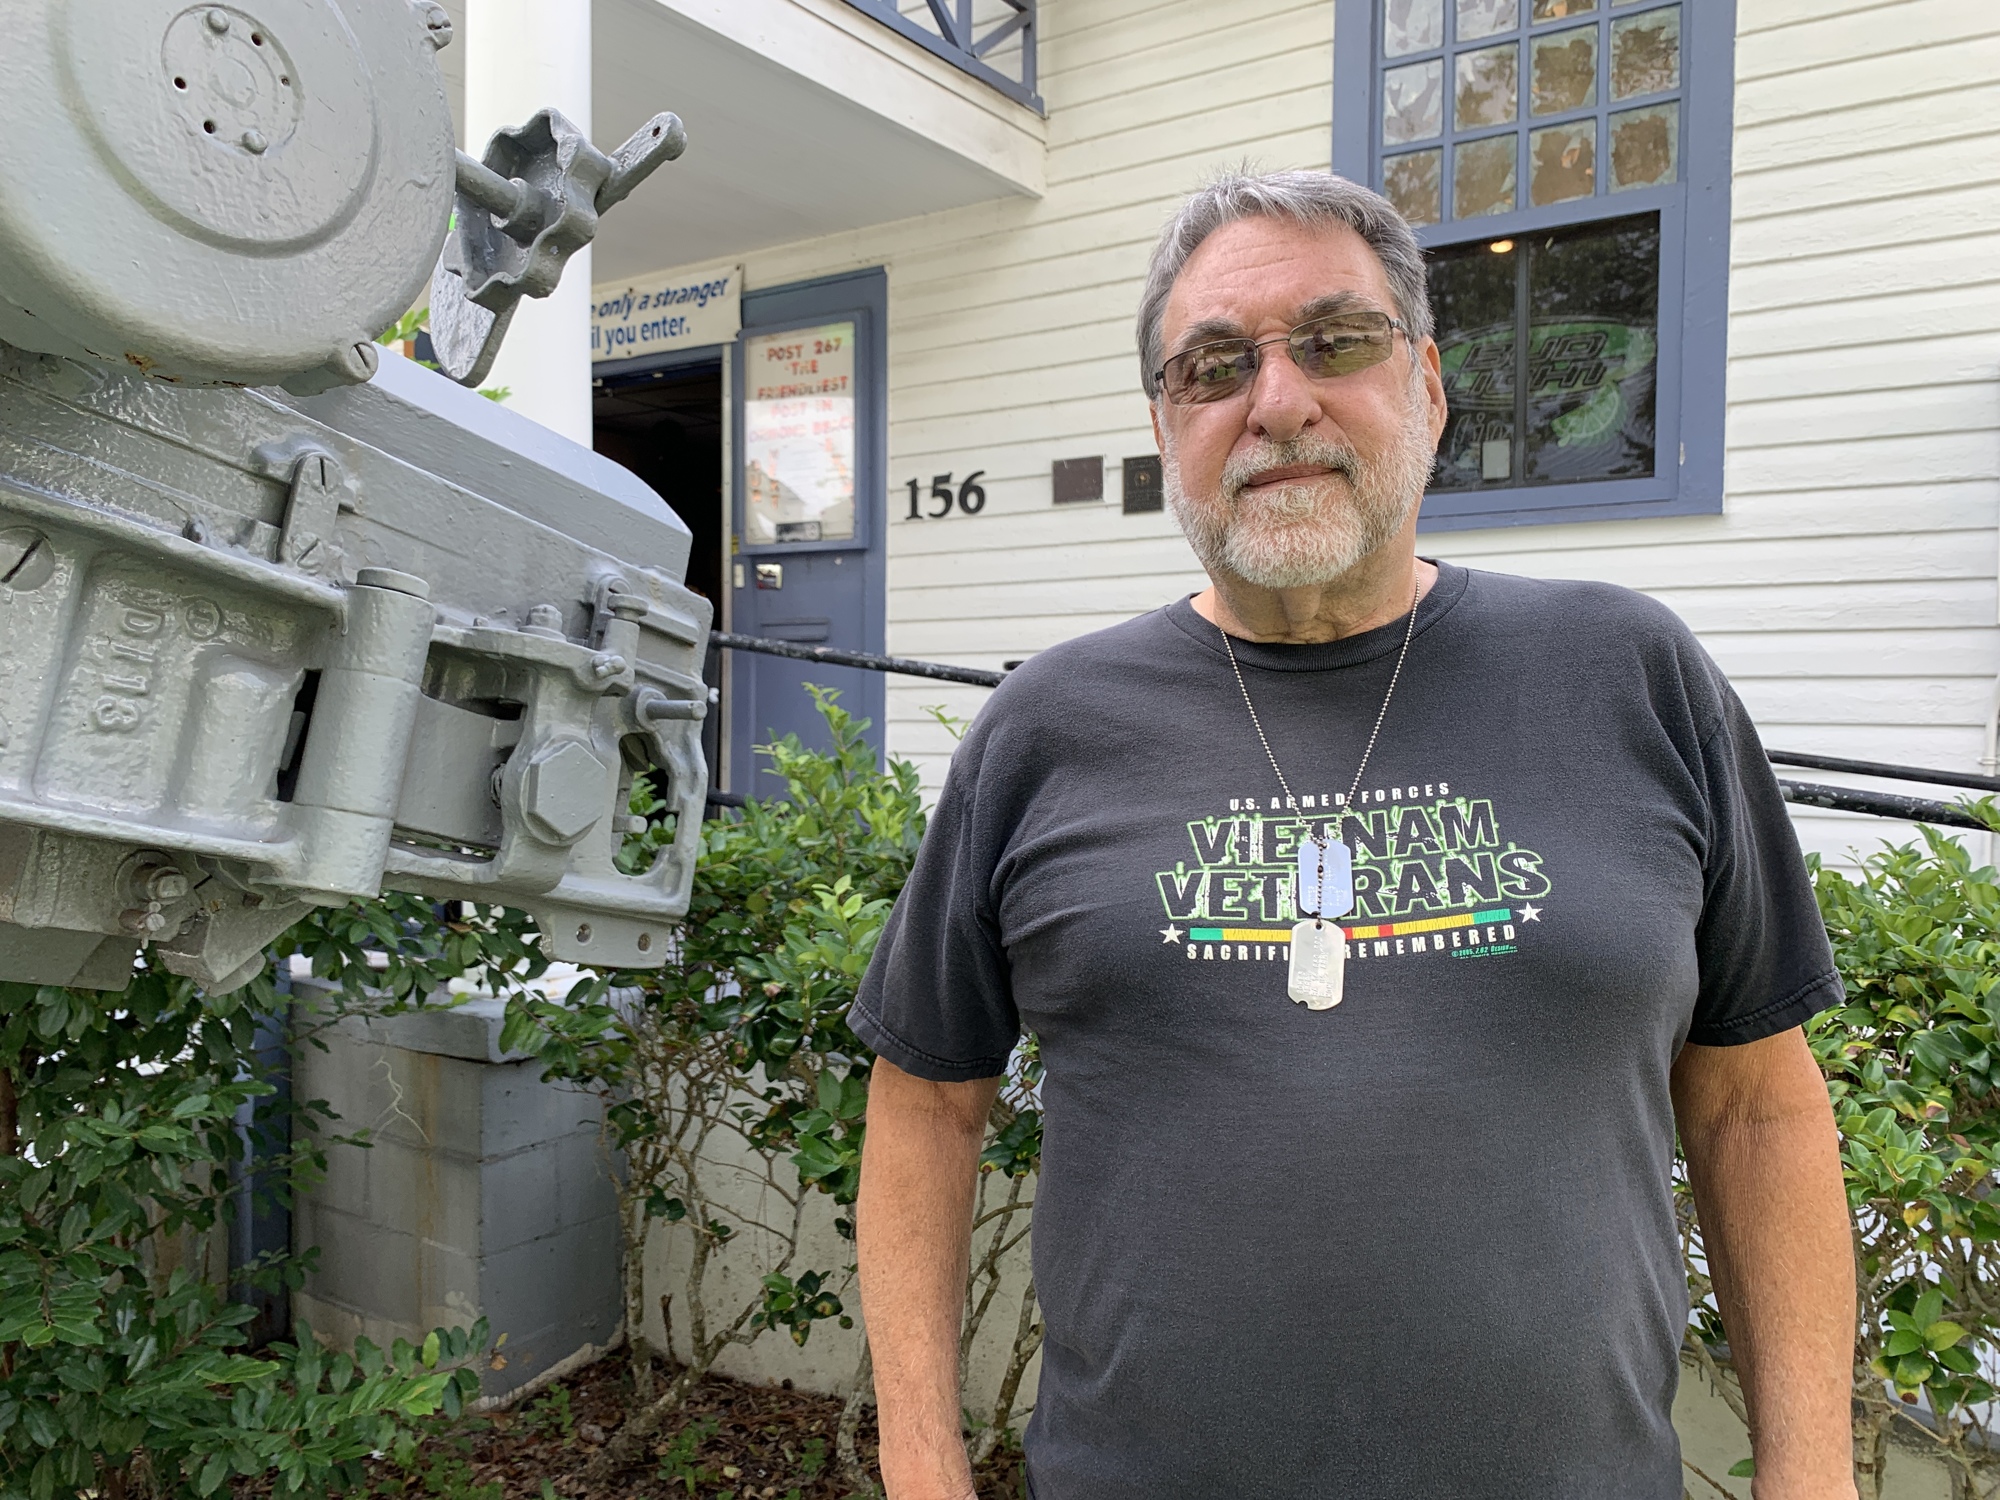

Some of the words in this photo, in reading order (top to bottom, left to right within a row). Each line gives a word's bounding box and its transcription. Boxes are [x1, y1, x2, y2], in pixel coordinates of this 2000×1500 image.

[599, 293, 635, 321] only
[638, 293, 651, 311] a
[653, 277, 729, 308] stranger
[605, 324, 636, 356] you
[641, 315, 691, 342] enter.
[767, 344, 804, 362] POST
[814, 337, 843, 355] 267
[791, 359, 819, 376] THE
[905, 471, 985, 521] 156
[1229, 798, 1261, 811] U.S.
[1270, 792, 1346, 810] ARMED
[1361, 782, 1450, 804] FORCES
[1187, 798, 1500, 867] VIETNAM
[1155, 846, 1553, 922] VETRANS
[1186, 943, 1289, 961] SACRIFI
